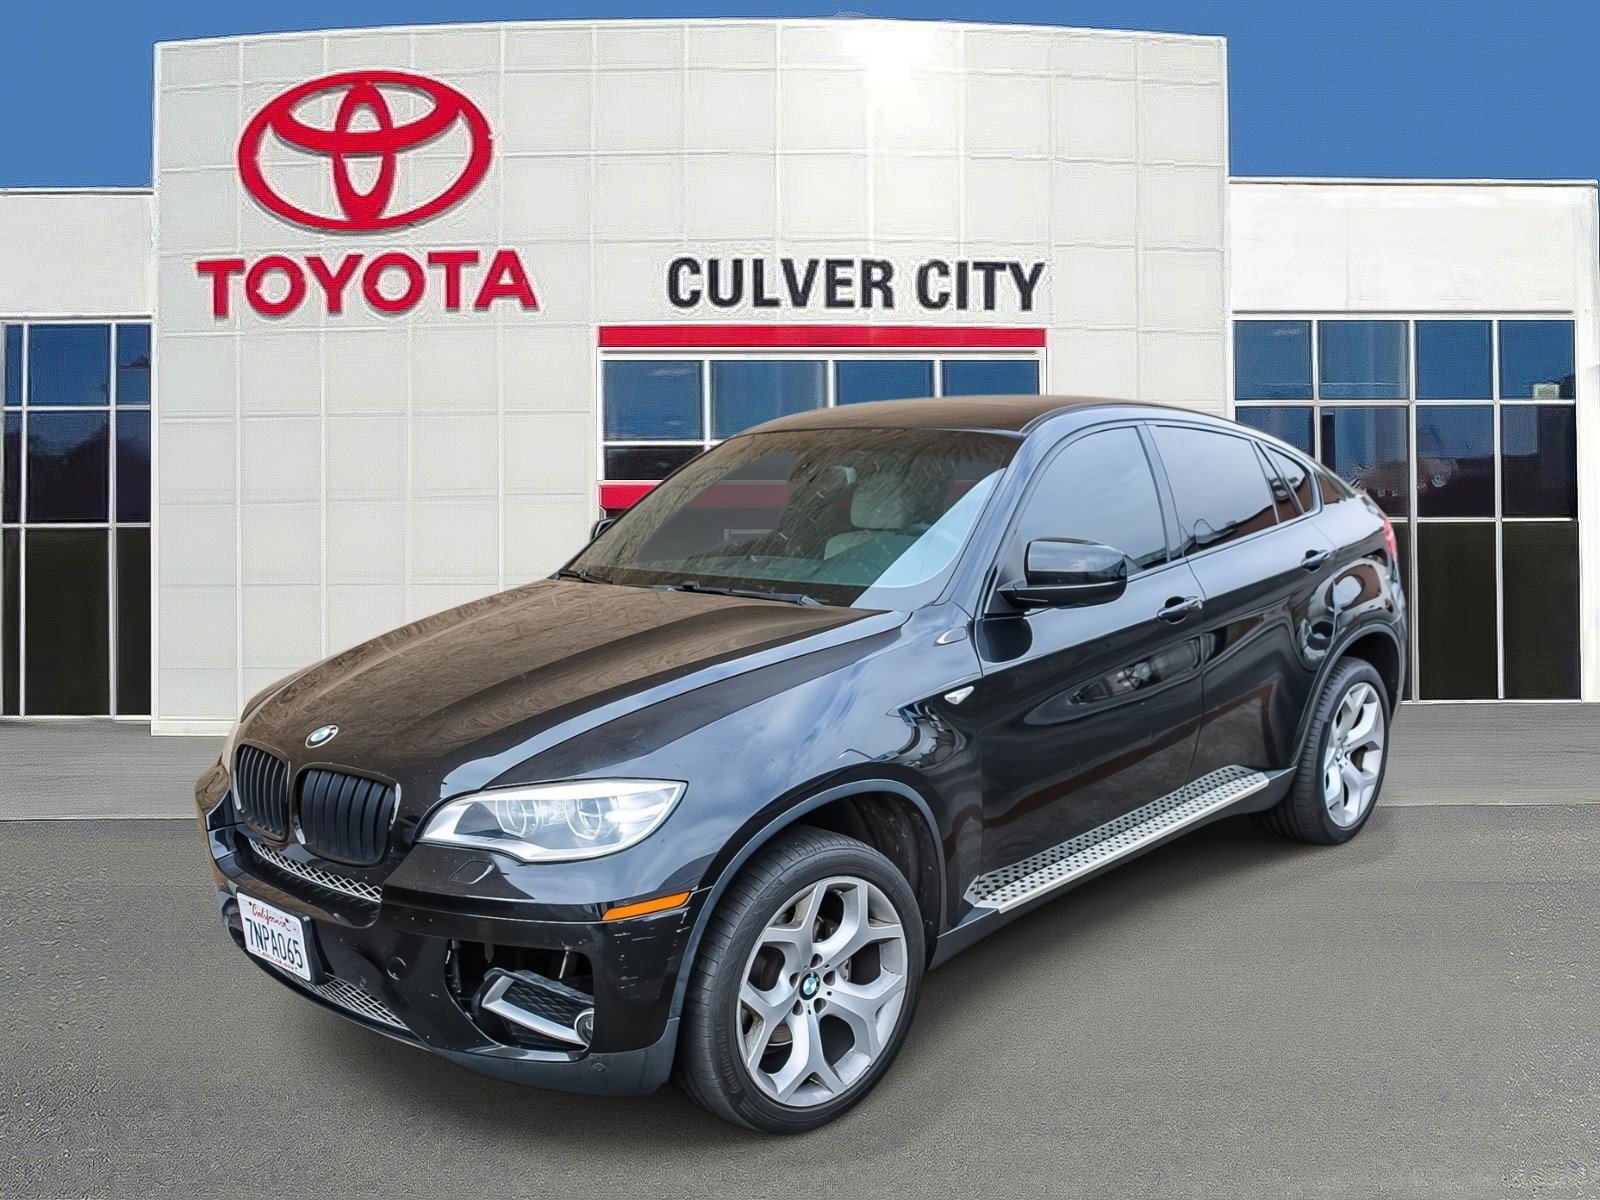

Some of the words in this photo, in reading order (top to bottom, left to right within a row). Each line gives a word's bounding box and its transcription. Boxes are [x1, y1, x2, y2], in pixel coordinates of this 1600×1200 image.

[196, 250, 538, 318] TOYOTA
[668, 257, 895, 309] CULVER
[917, 260, 1045, 311] CITY
[245, 917, 303, 969] 7NPA065
[252, 903, 292, 932] California
